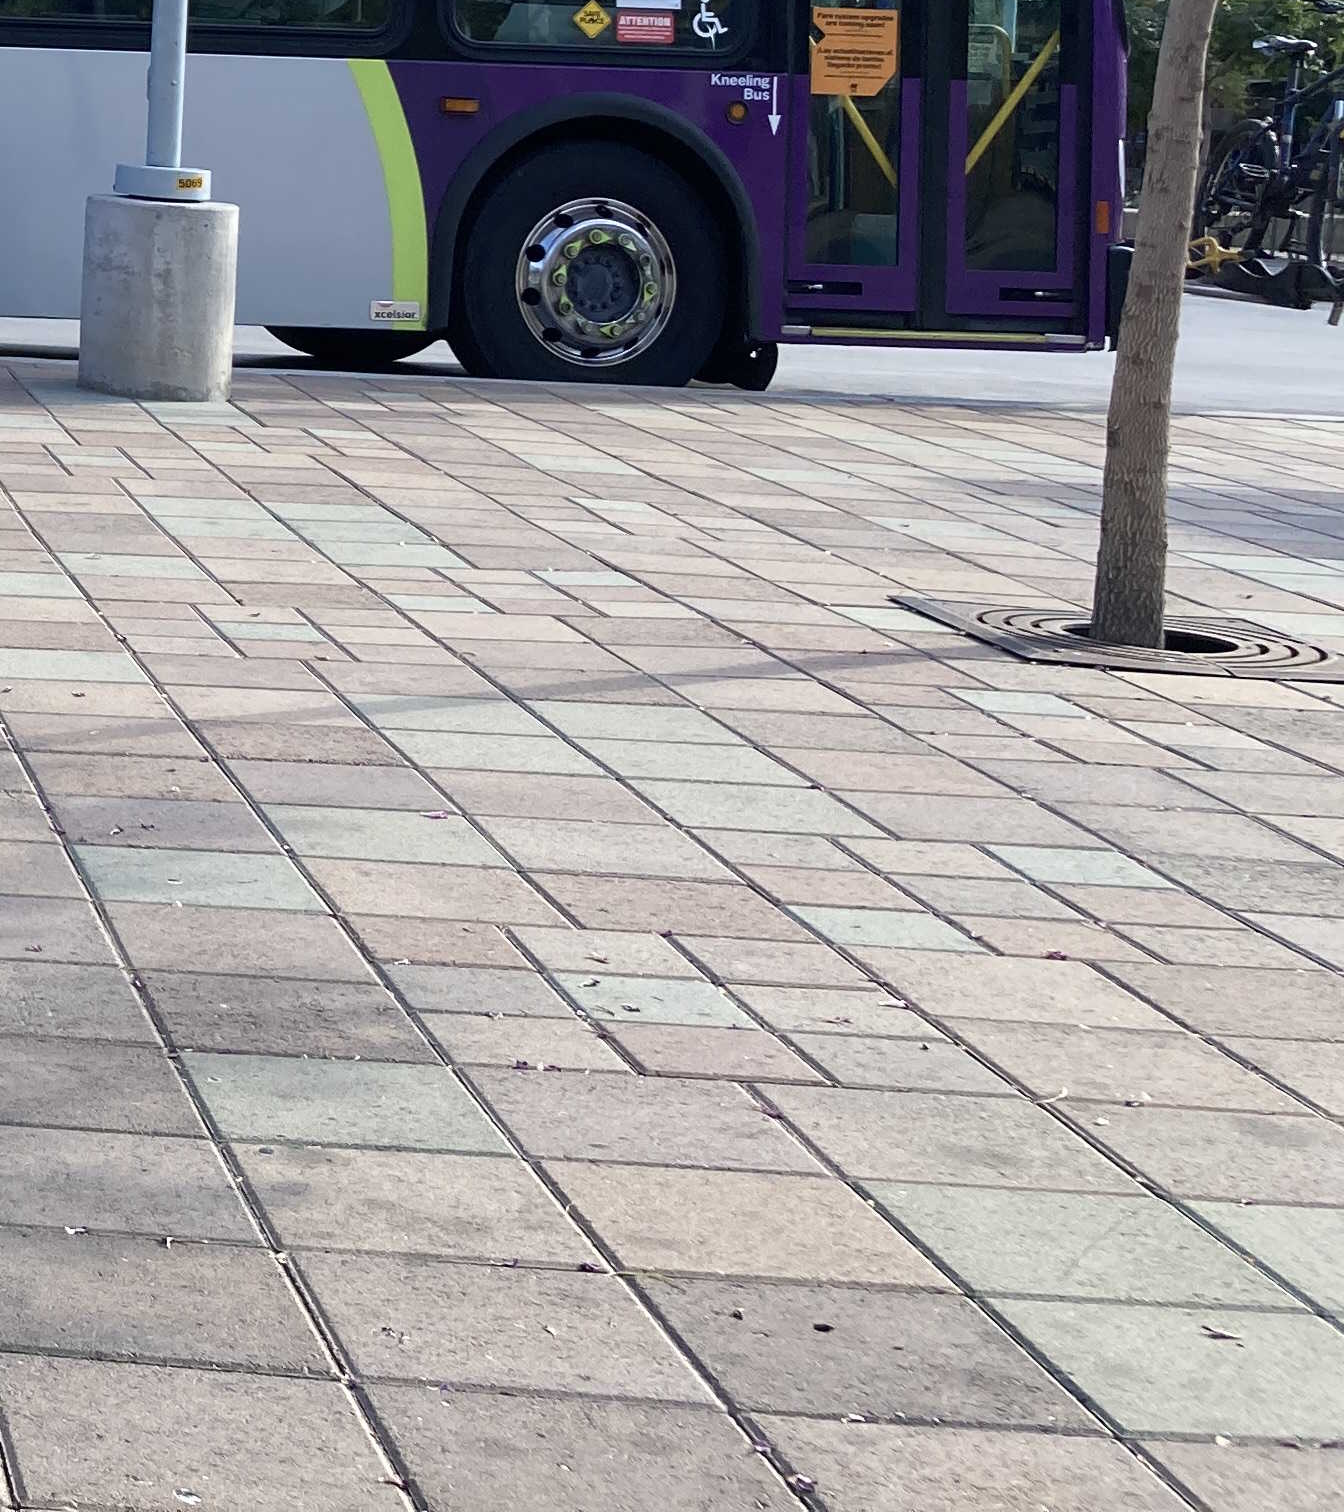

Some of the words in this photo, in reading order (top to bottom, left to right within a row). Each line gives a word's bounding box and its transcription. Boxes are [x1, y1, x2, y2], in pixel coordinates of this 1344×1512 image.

[618, 15, 671, 26] ATTENTION
[710, 73, 770, 89] Kneeling
[743, 88, 770, 100] Bus
[178, 178, 202, 188] 5069
